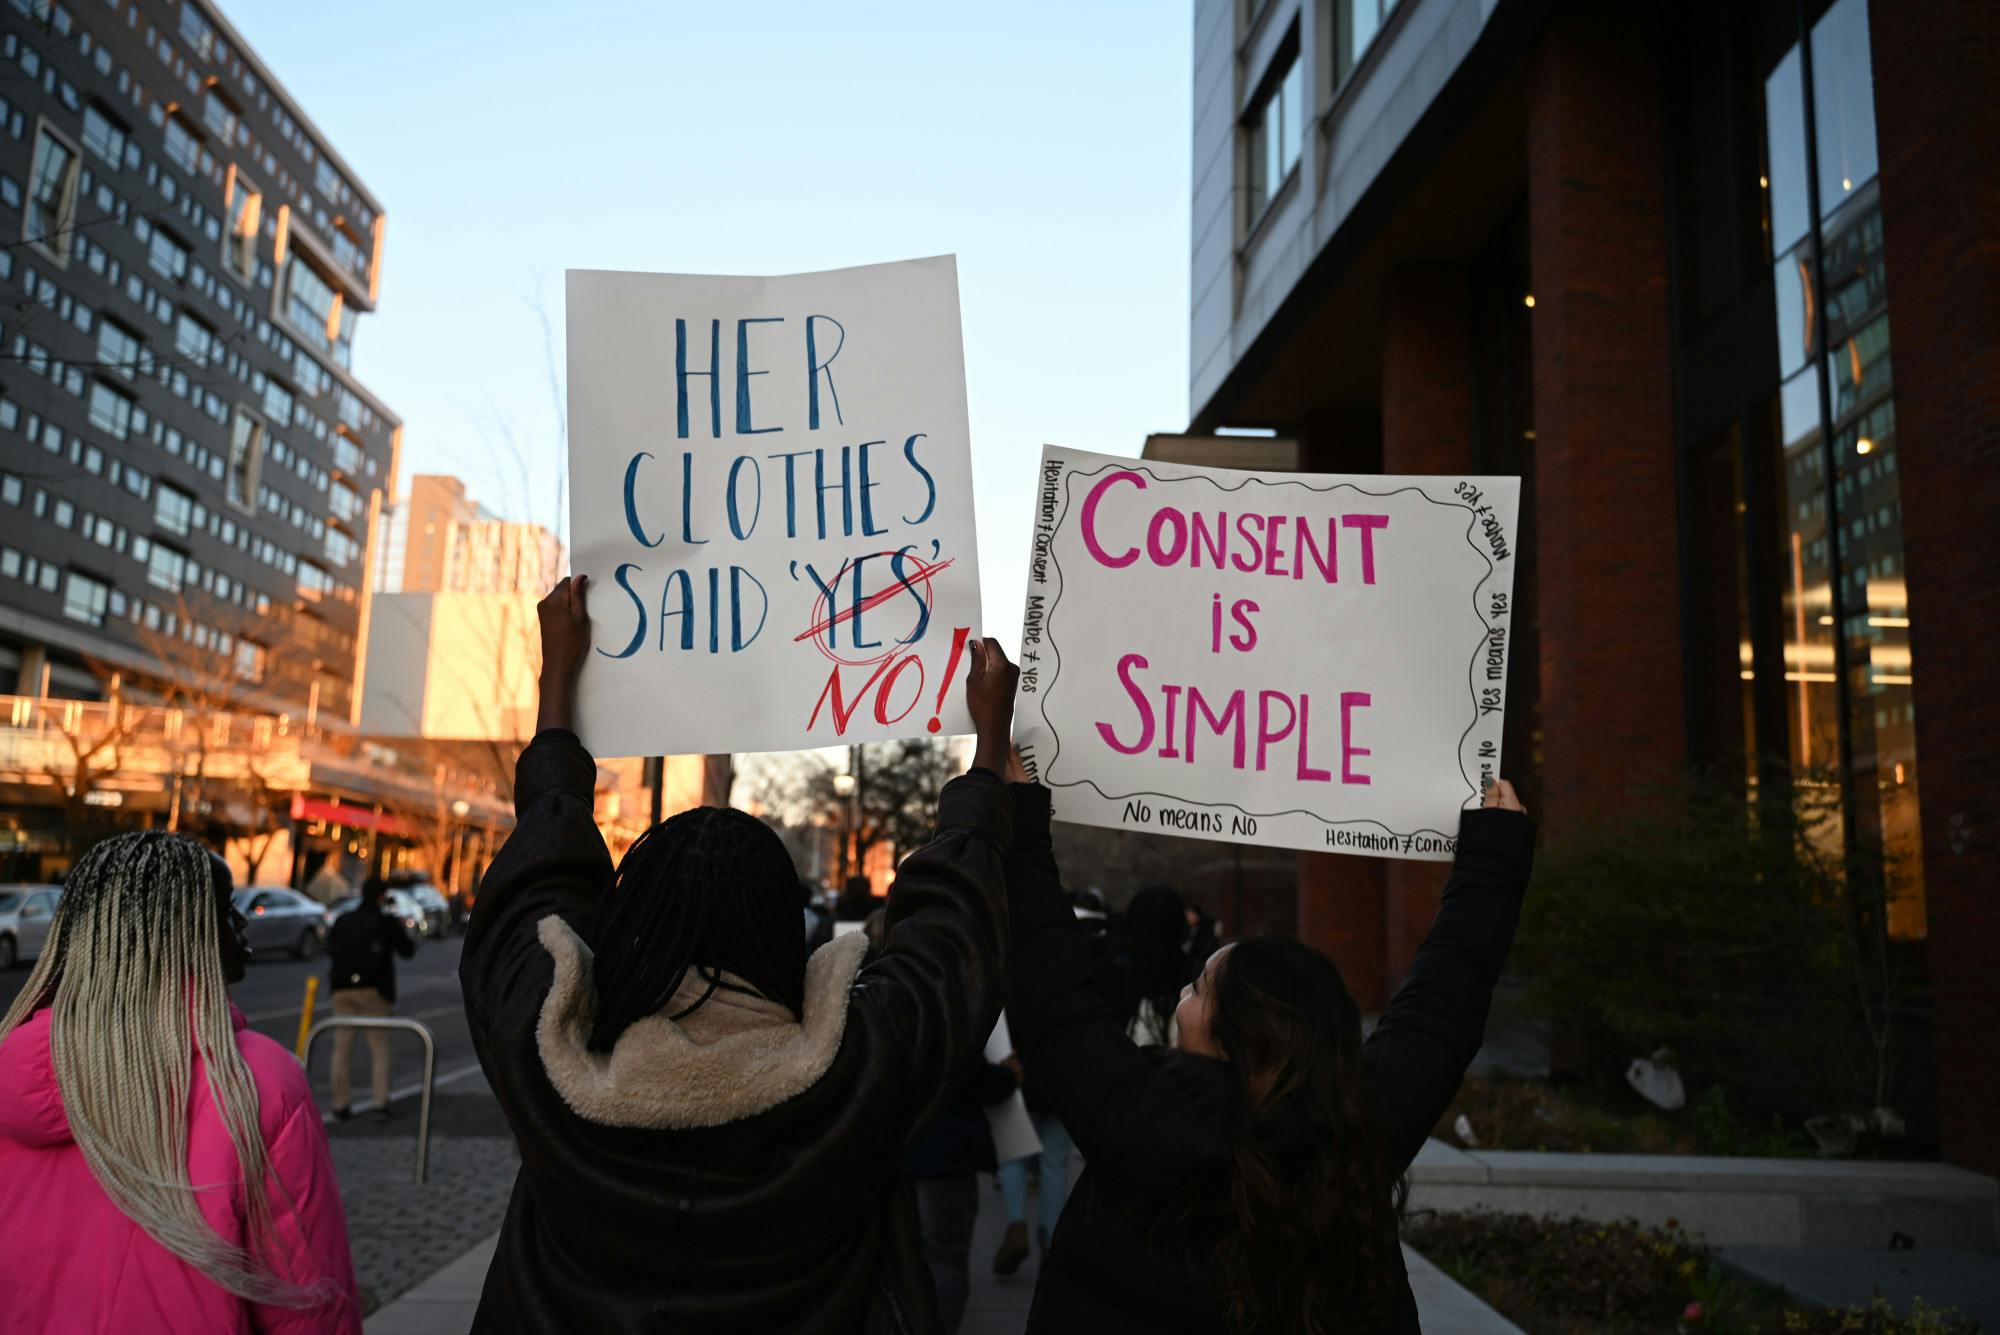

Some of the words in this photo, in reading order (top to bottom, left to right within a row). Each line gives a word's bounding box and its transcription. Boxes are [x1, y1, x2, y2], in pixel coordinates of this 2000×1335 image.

[676, 315, 844, 438] HER
[623, 433, 936, 547] CLOTHES
[1042, 460, 1064, 522] Hesitation
[1080, 471, 1389, 585] CONSENT
[596, 563, 768, 659] SAID
[1024, 596, 1045, 645] Maybe
[807, 627, 970, 736] NO!
[1486, 627, 1506, 680] means
[1095, 654, 1371, 785] SIMPLE
[1478, 740, 1497, 758] No
[1122, 799, 1151, 823] No
[1159, 808, 1222, 833] means
[1326, 829, 1399, 851] Hesitation
